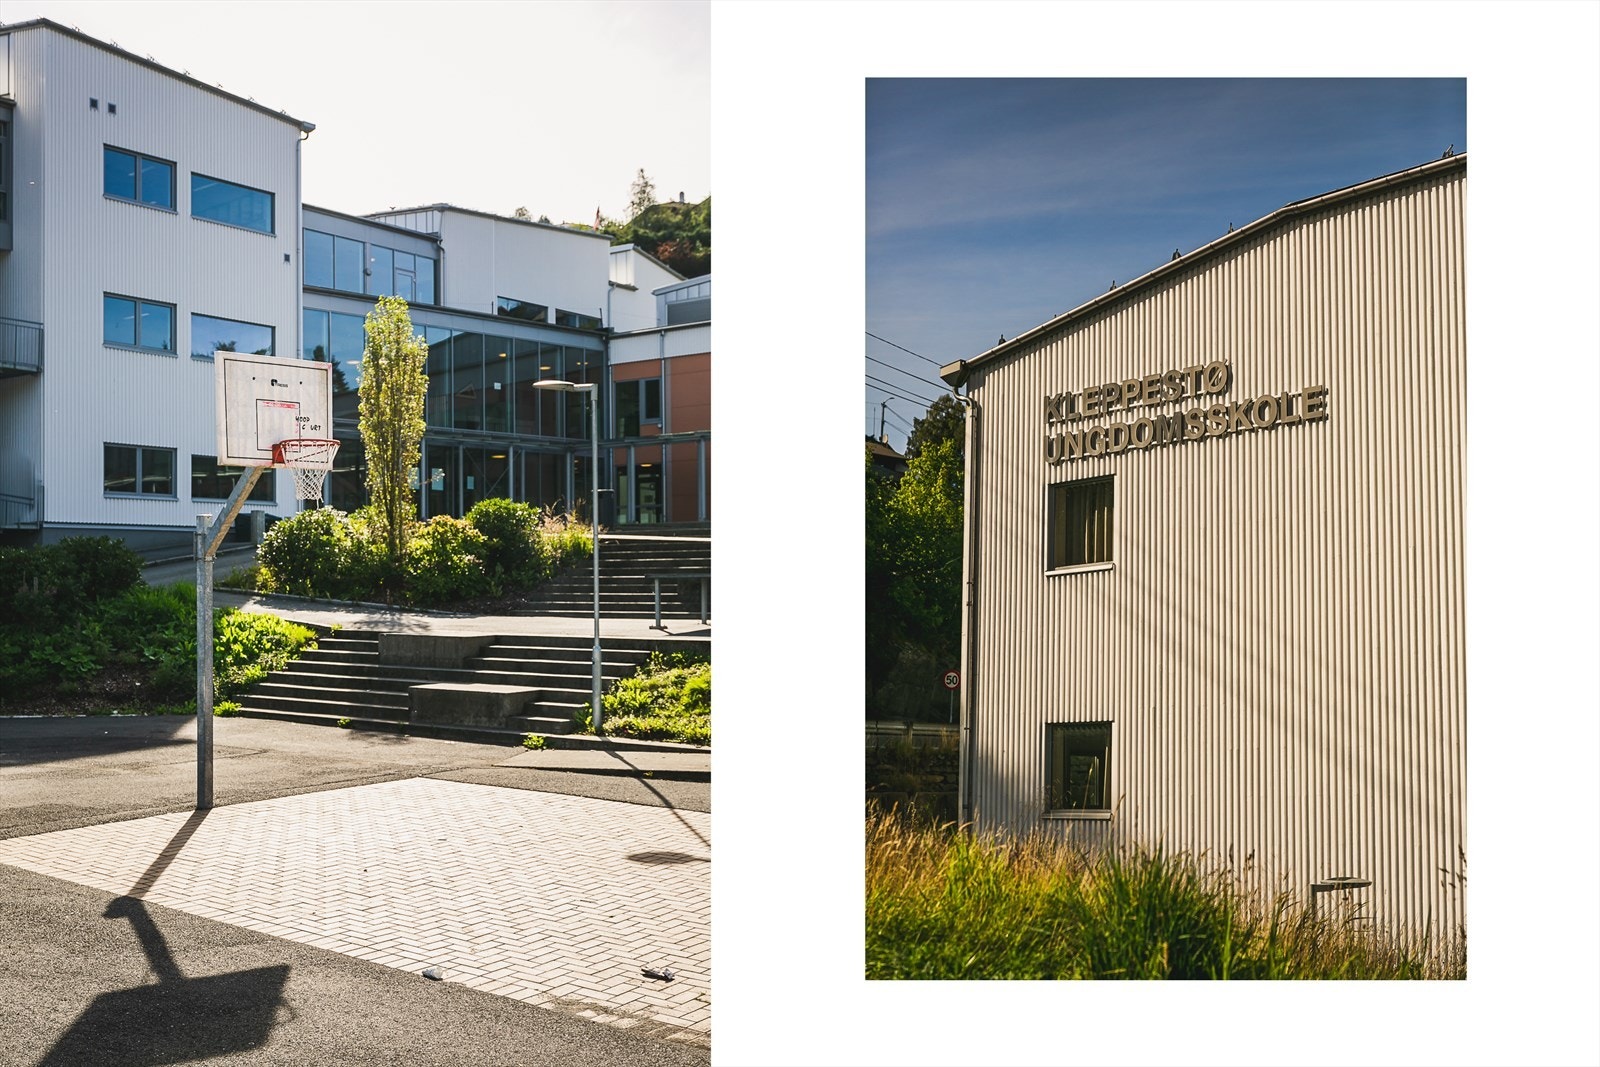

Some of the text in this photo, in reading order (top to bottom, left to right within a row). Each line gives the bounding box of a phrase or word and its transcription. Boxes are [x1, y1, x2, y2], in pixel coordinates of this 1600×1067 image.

[1044, 359, 1231, 424] KLEPPESTØ
[1044, 385, 1328, 464] UNGDOMSSKOLE
[946, 675, 958, 685] 50
